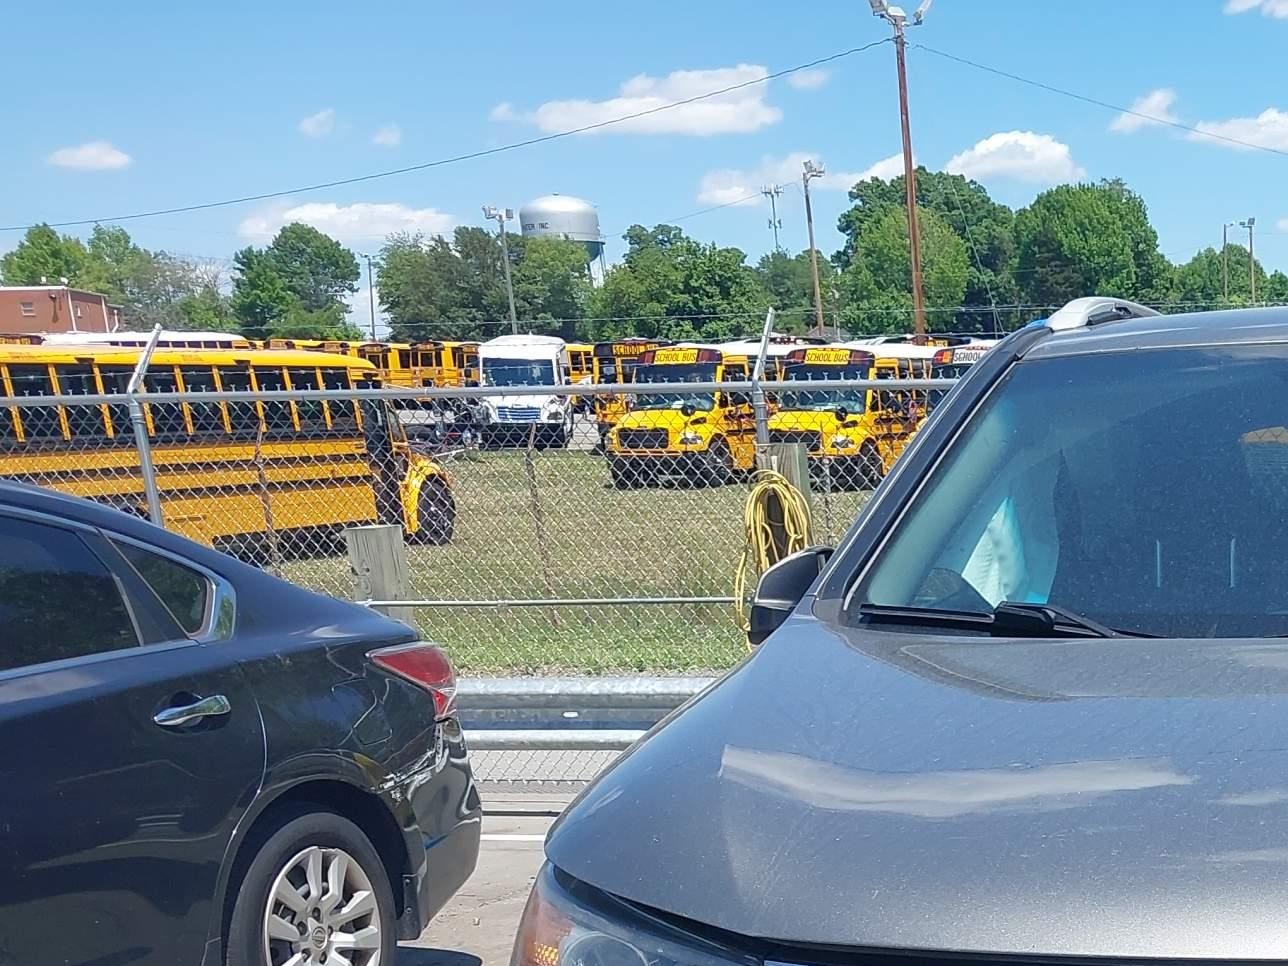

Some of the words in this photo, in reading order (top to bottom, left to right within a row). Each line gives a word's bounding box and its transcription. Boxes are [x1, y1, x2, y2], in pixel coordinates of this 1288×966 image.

[655, 352, 680, 362] SCHOOL
[682, 352, 697, 362] BUS
[806, 352, 832, 361] SCHOOL
[834, 352, 849, 361] BUS
